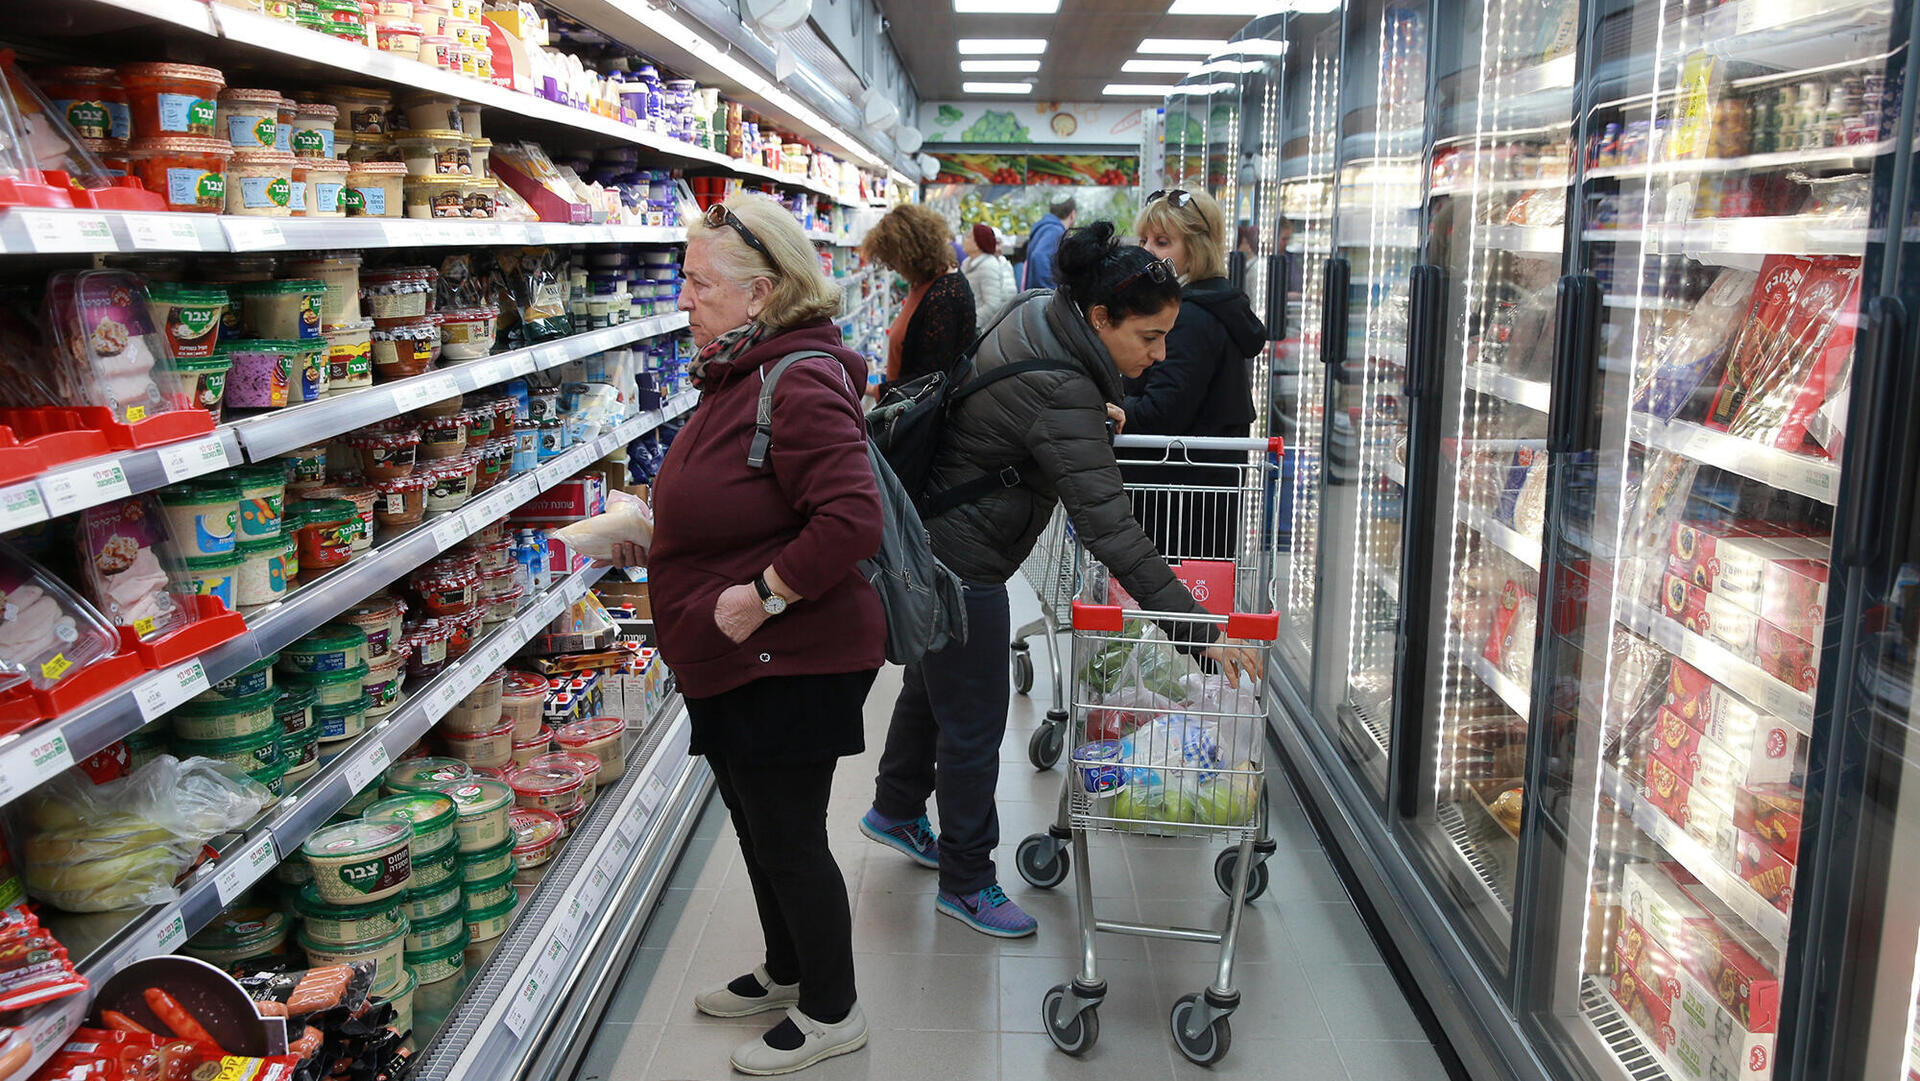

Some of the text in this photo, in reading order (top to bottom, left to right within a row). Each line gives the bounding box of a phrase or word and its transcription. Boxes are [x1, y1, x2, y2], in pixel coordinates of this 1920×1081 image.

[73, 109, 103, 121] צבר
[195, 107, 214, 120] צבר
[260, 124, 276, 133] צבר
[298, 136, 320, 145] צבר
[204, 180, 223, 192] צבר
[273, 184, 289, 193] צבר
[346, 196, 359, 205] צב
[184, 311, 211, 321] צבר
[350, 363, 367, 371] צבר
[298, 465, 318, 473] צבר
[551, 501, 574, 509] שמנת
[624, 634, 647, 642] שמנת
[293, 655, 314, 663] צבר
[256, 745, 273, 757] צבר
[388, 849, 408, 865] חומוס
[344, 863, 378, 880] צבר
[157, 923, 174, 939] רמי לוי
